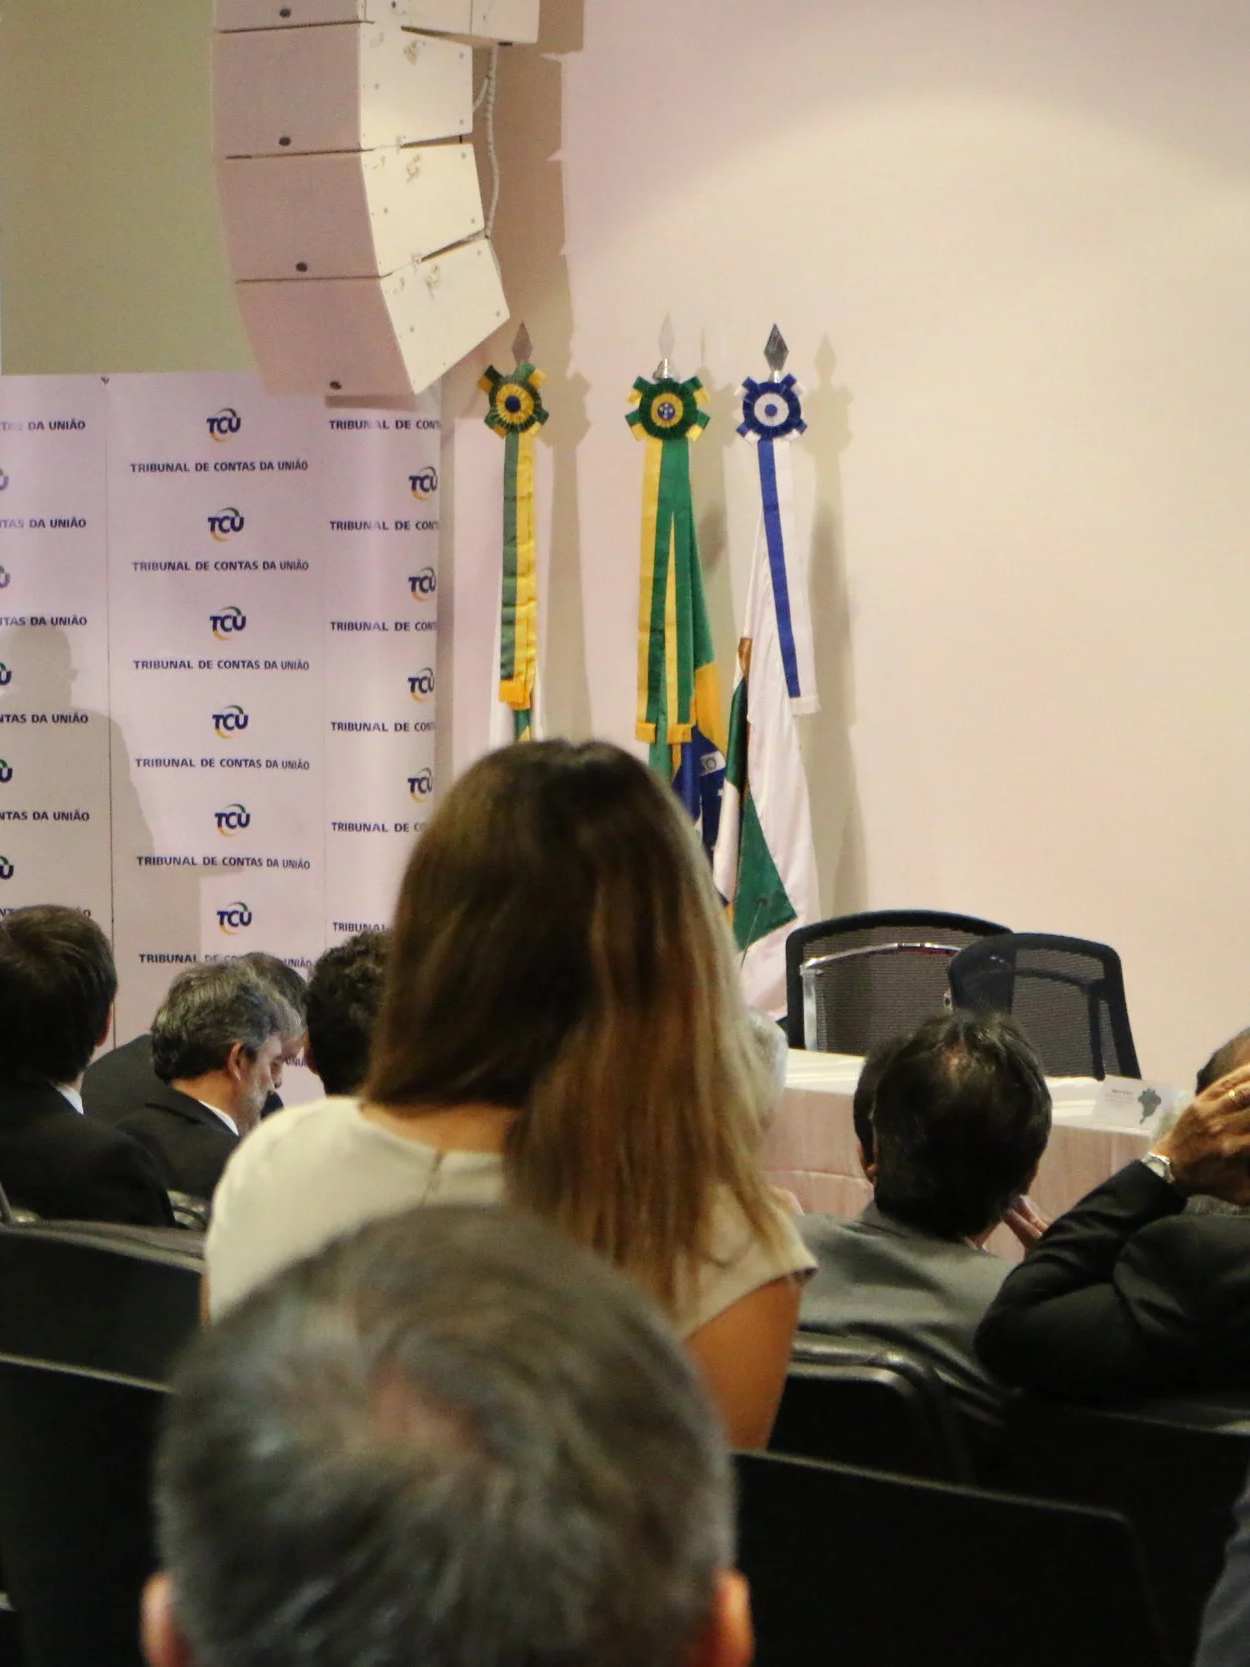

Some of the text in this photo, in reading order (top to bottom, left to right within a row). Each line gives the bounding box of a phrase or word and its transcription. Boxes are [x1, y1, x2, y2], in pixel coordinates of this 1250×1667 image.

[28, 421, 45, 430] DA
[49, 418, 86, 430] UNIÃO
[206, 416, 241, 435] TCU
[395, 420, 411, 430] DE
[130, 460, 308, 473] TRIBUNAL DE CONTAS DA UNIÃO
[30, 519, 46, 528] DA
[50, 516, 86, 528] UNIÃO
[208, 516, 244, 533] TCU
[330, 521, 389, 530] TRIBUNAL
[395, 521, 410, 530] DE
[132, 560, 309, 572] TRIBUNAL DE CONTAS DA UNIÃO
[30, 616, 47, 626] DA
[51, 614, 88, 626] UNIÃO
[210, 614, 246, 633] TCU
[330, 622, 388, 631] TRIBUNAL
[394, 622, 410, 631] DE
[134, 660, 310, 672] TRIBUNAL DE CONTAS DA UNIÃO
[32, 714, 48, 723] DA
[52, 711, 89, 724] UNIÃO
[212, 714, 248, 731] TCU
[330, 722, 388, 732] TRIBUNAL
[394, 722, 410, 732] DE
[135, 758, 310, 770] TRIBUNAL DE CONTAS DA UNIÃO
[32, 811, 49, 820] DA
[53, 808, 90, 821] UNIÃO
[215, 812, 250, 829] TCU
[332, 822, 388, 832] TRIBUNAL
[394, 822, 410, 832] DE
[137, 856, 310, 870] TRIBUNAL DE CONTAS DA UNIÃO
[217, 910, 252, 927] TCU
